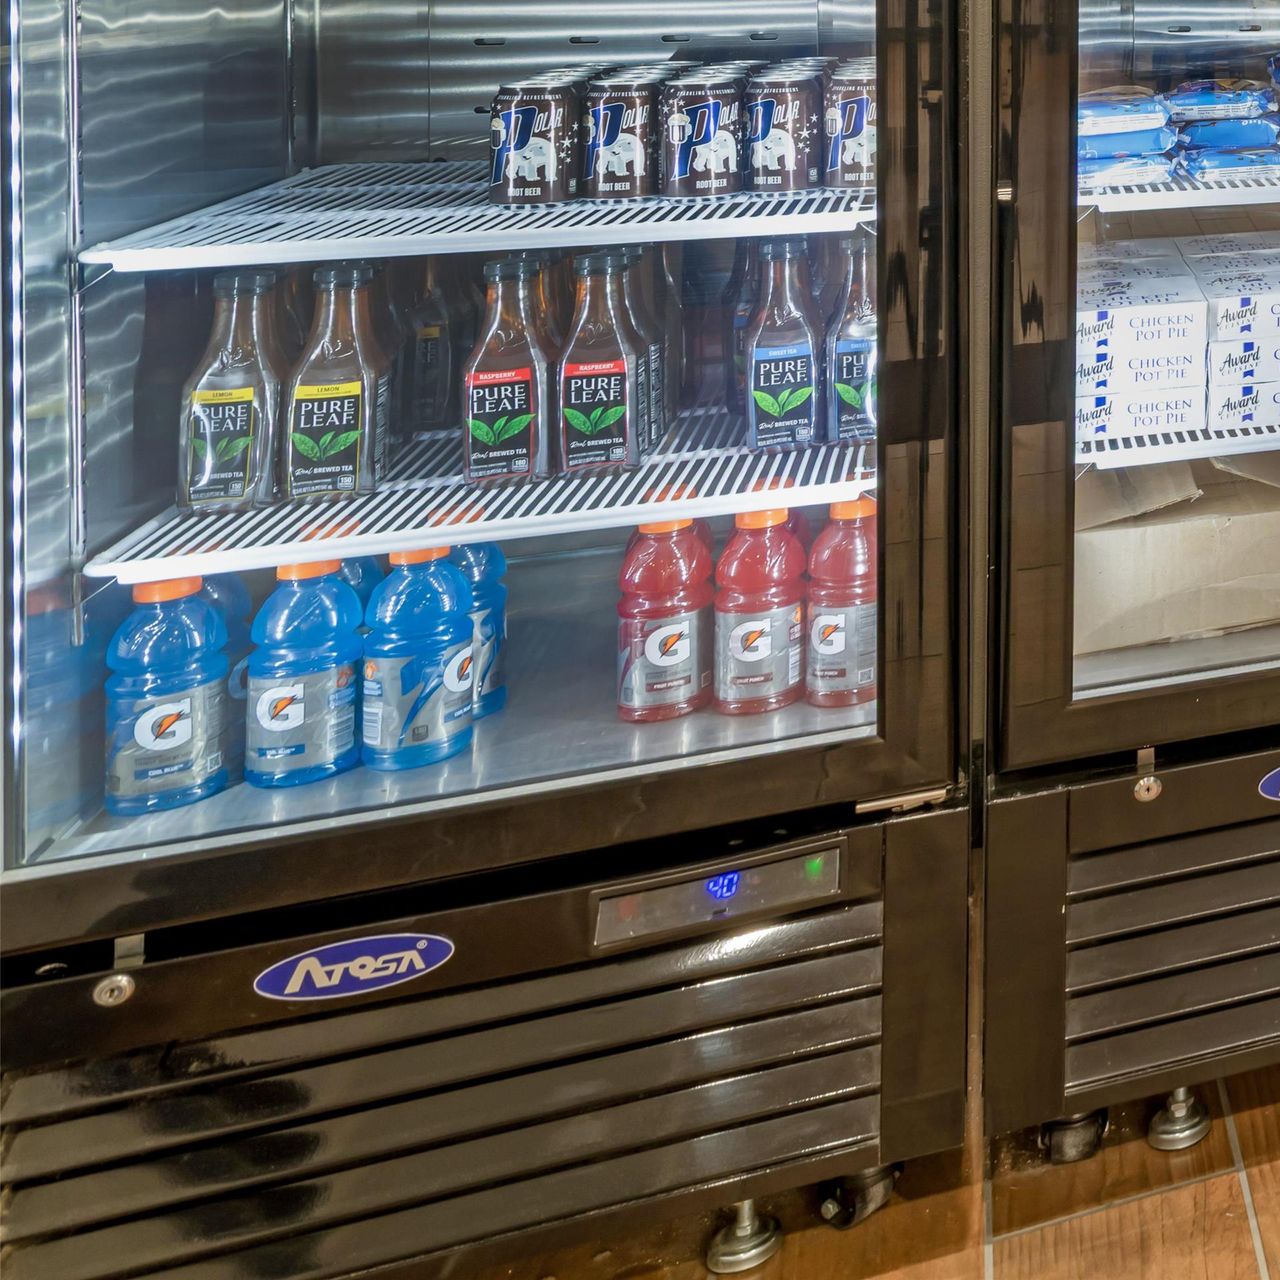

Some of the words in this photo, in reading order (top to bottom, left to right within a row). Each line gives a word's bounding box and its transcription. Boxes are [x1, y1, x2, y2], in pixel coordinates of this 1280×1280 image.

[525, 187, 541, 196] BEER
[1129, 314, 1193, 329] CHICKEN
[1136, 330, 1160, 341] POT
[1168, 329, 1188, 338] PIE
[760, 359, 807, 374] PURE
[1128, 355, 1193, 370] CHICKEN
[479, 372, 516, 380] RASPBERRY
[760, 371, 805, 386] LEAF
[1135, 370, 1160, 382] POT
[1168, 369, 1187, 379] PIE
[571, 377, 621, 391] PURE
[473, 384, 526, 402] PURE
[571, 389, 618, 403] LEAF
[201, 404, 248, 419] PURE
[301, 399, 355, 414] PURE
[473, 397, 524, 413] LEAF
[1127, 400, 1192, 414] CHICKEN
[201, 419, 245, 432] LEAF
[301, 414, 352, 428] LEAF
[1134, 415, 1160, 427] POT
[1166, 414, 1186, 423] PIE
[489, 449, 515, 457] BREWED
[313, 466, 340, 474] BREWED
[134, 698, 192, 751] G
[708, 873, 738, 898] 40
